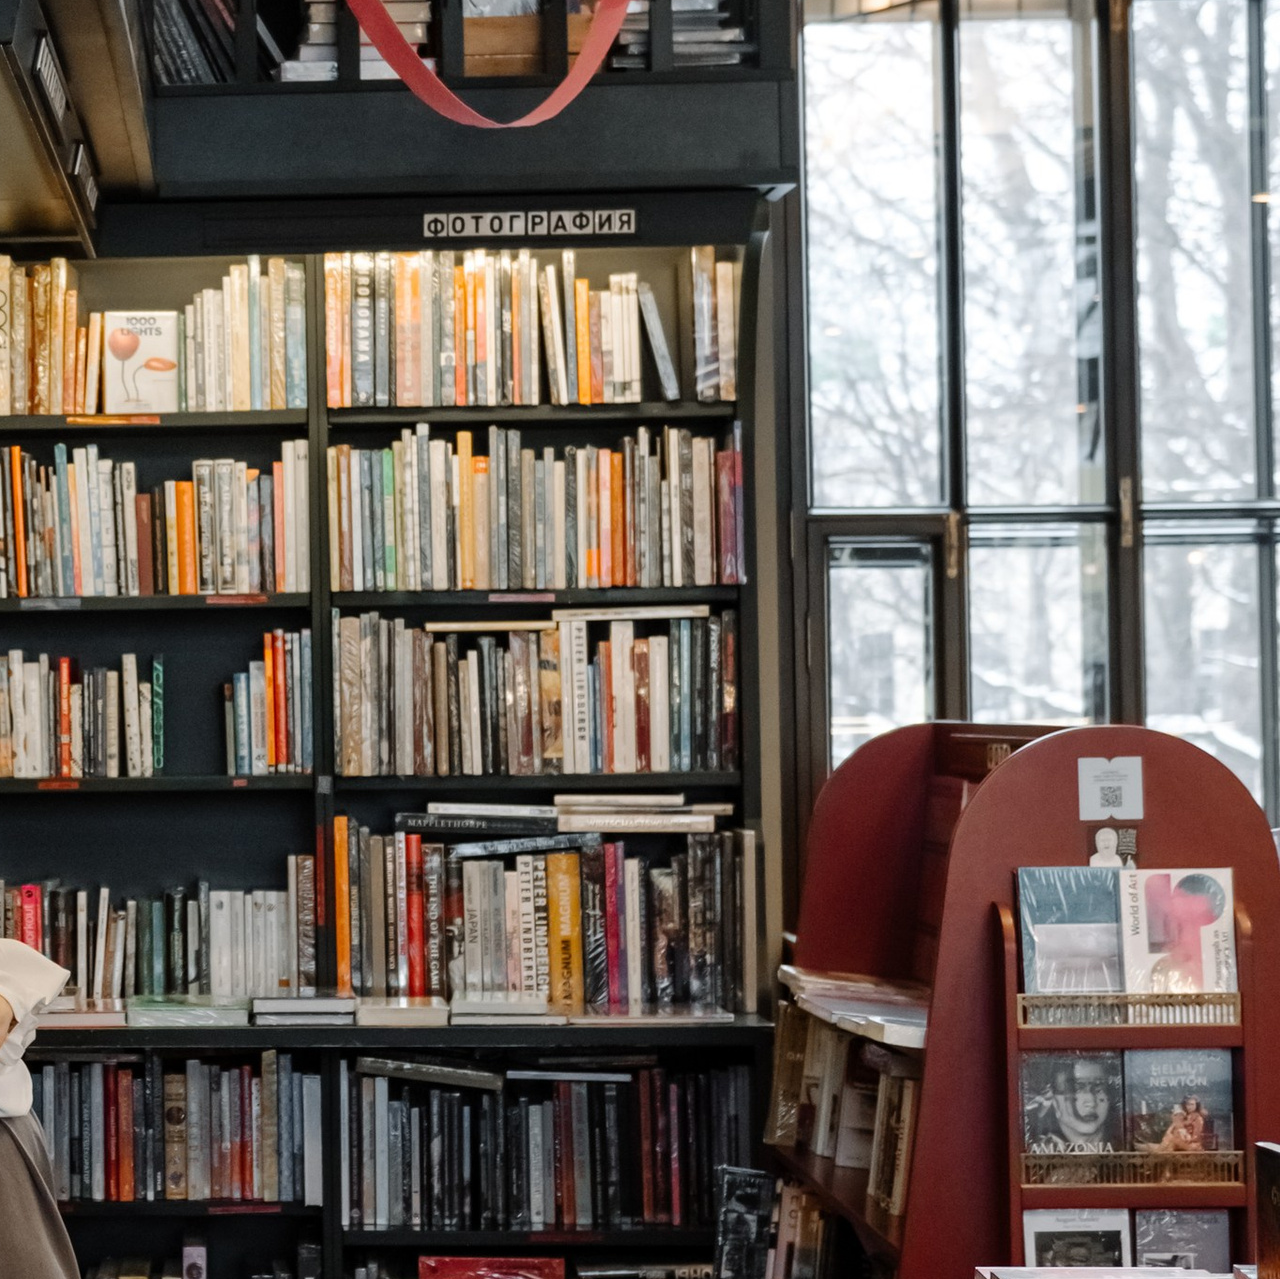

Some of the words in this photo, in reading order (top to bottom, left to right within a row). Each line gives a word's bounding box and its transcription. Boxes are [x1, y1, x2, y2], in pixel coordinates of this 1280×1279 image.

[426, 213, 633, 236] ФОТОГРАФИЯ
[356, 267, 370, 362] RONORAMA
[429, 874, 439, 895] THE
[520, 861, 531, 904] PETER
[533, 861, 546, 906] PETER
[1127, 874, 1138, 890] Art
[429, 897, 439, 920] END
[558, 874, 571, 937] MAGNUM
[1128, 892, 1139, 903] of
[430, 922, 439, 937] OF
[466, 908, 479, 944] JAPAN
[1129, 905, 1140, 936] World
[431, 939, 440, 959] THE
[521, 911, 534, 992] LINDBERGH
[535, 912, 549, 993] LINDBERGH
[431, 961, 440, 989] GAME
[1149, 1075, 1208, 1087] NEWTON
[1151, 1063, 1206, 1076] HELMUT
